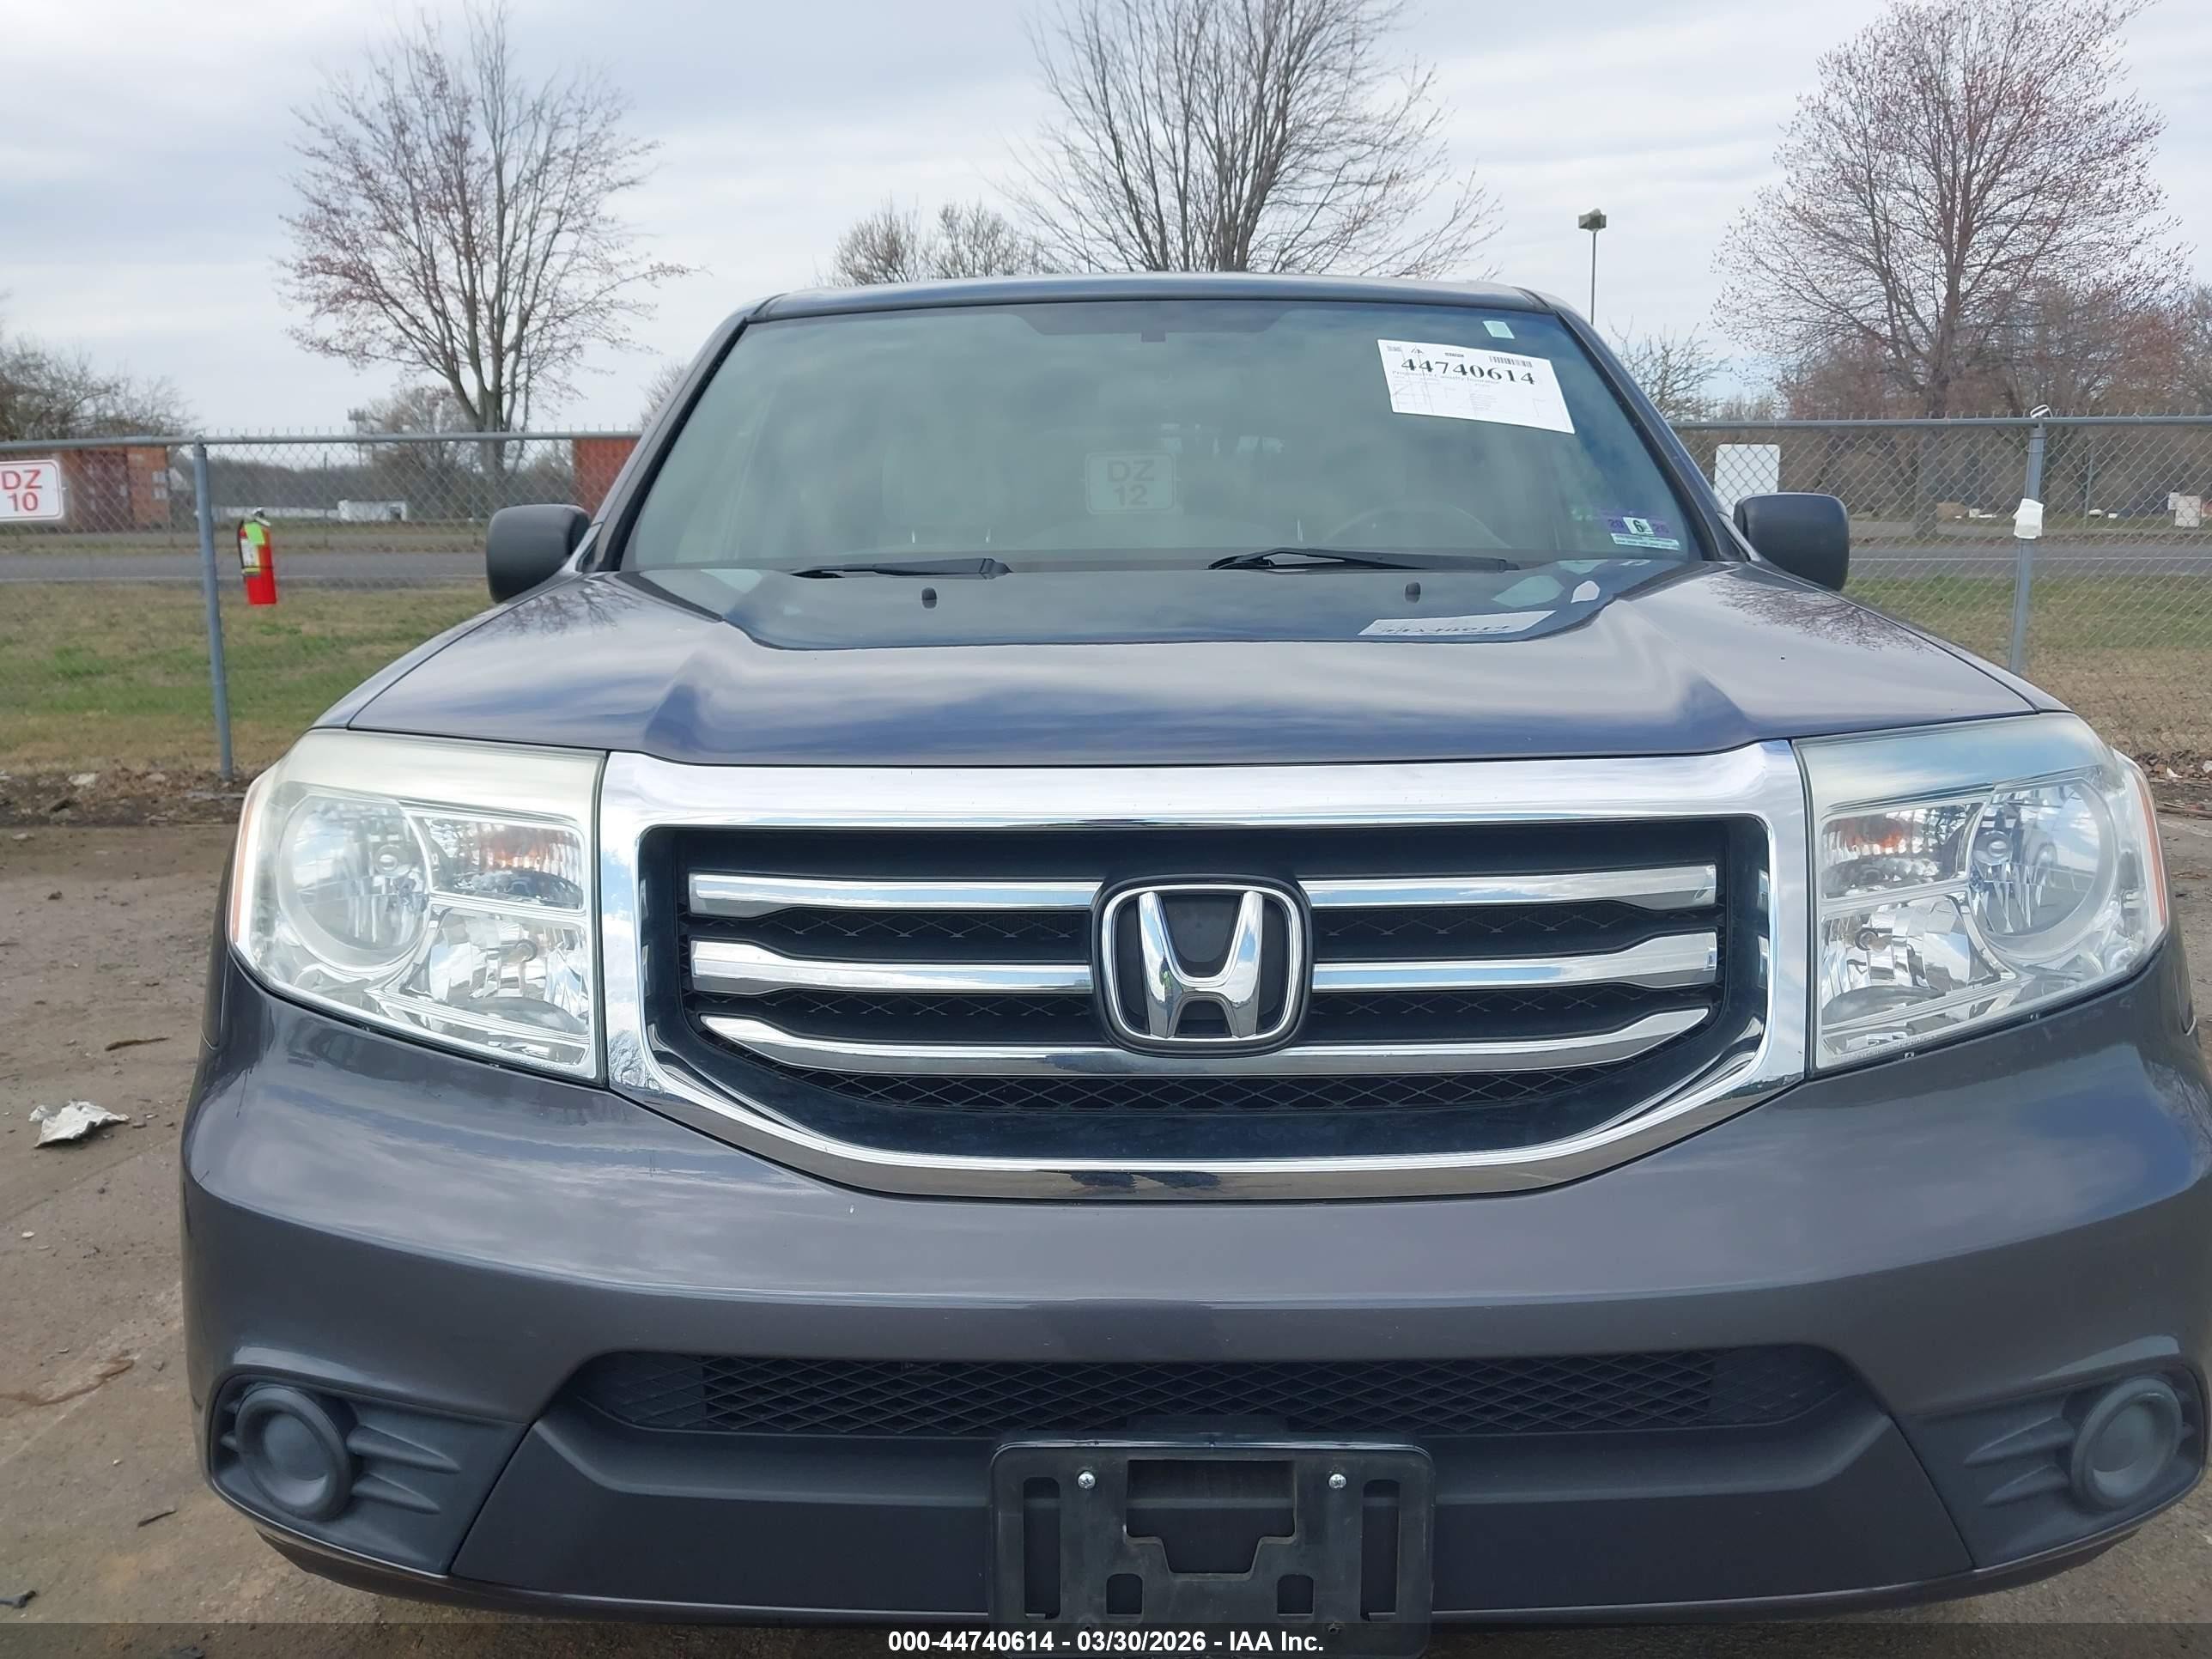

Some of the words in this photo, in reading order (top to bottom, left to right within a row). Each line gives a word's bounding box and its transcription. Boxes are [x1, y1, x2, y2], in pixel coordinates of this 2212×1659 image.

[1401, 358, 1535, 386] 44740614
[2, 470, 42, 490] DZ
[1106, 459, 1155, 482] DZ
[7, 492, 39, 512] 10
[1113, 484, 1148, 507] 12
[1632, 519, 1644, 533] 6
